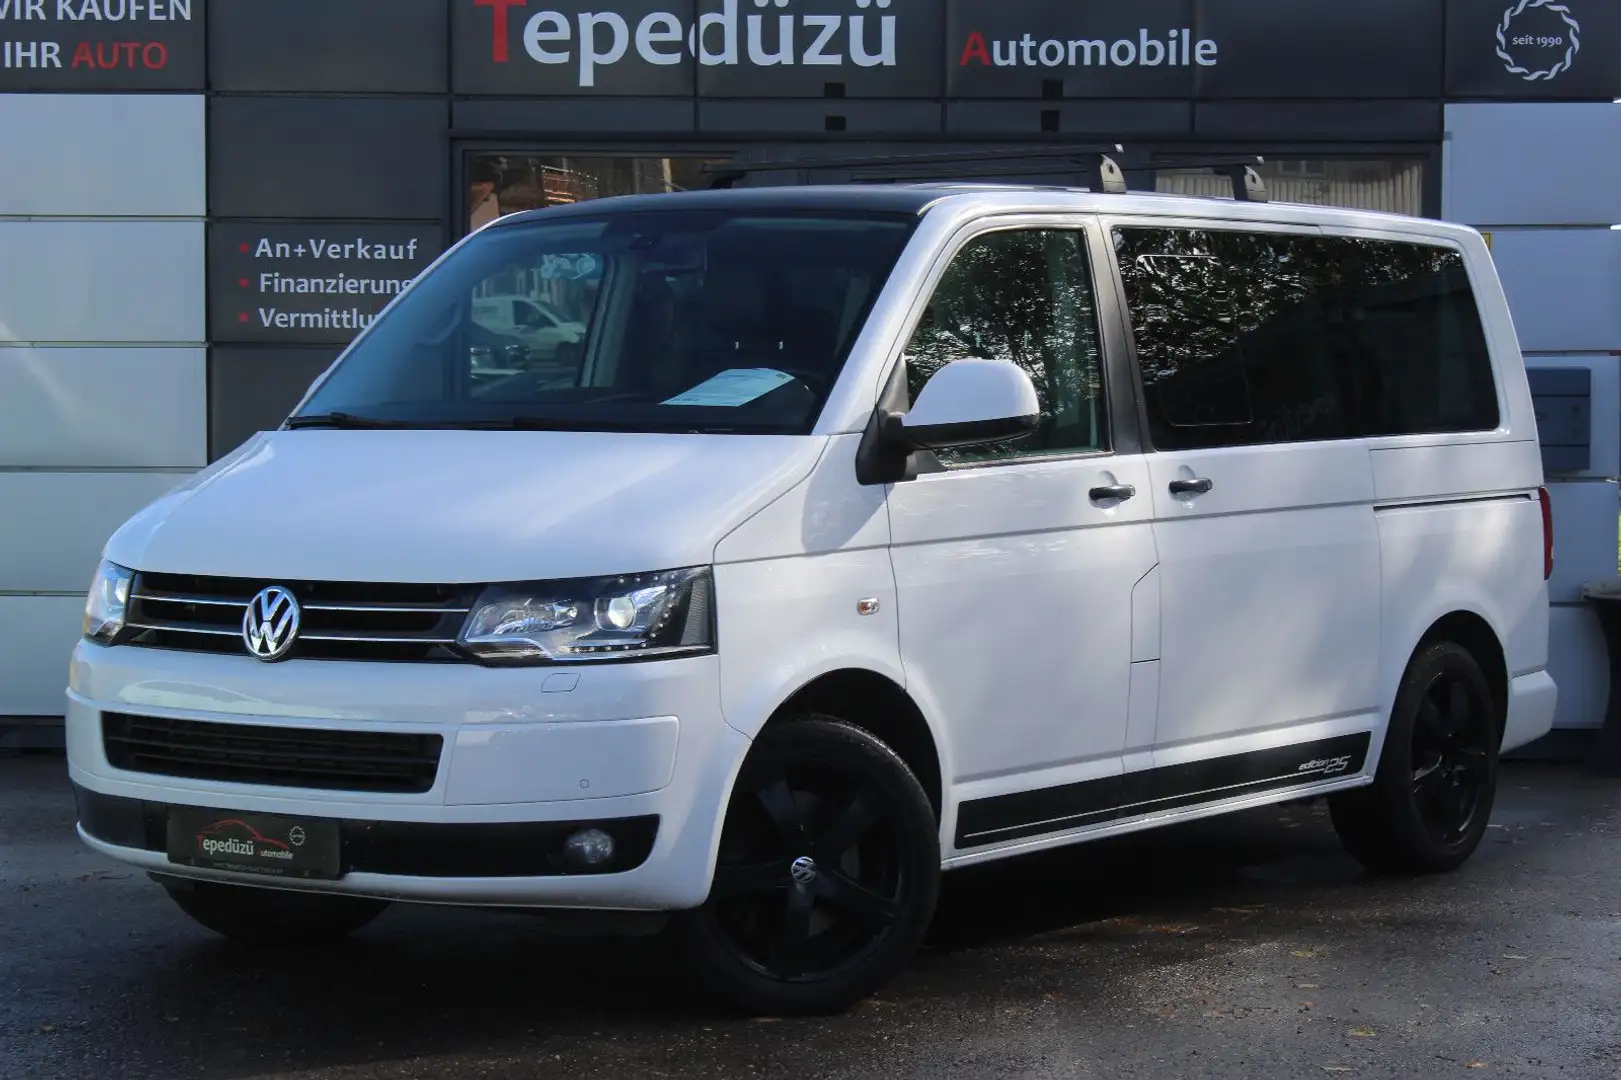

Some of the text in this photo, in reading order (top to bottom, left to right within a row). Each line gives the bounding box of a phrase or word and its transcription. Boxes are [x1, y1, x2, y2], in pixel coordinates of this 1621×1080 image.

[57, 0, 191, 20] KAUFEN
[474, 0, 1218, 87] Tepedüzü Automobile
[1512, 35, 1563, 47] seit 1990
[4, 41, 168, 69] IHR AUTO
[254, 238, 418, 260] An+Verkauf
[259, 309, 378, 329] Vermittlu
[197, 834, 254, 856] Tepedüzü
